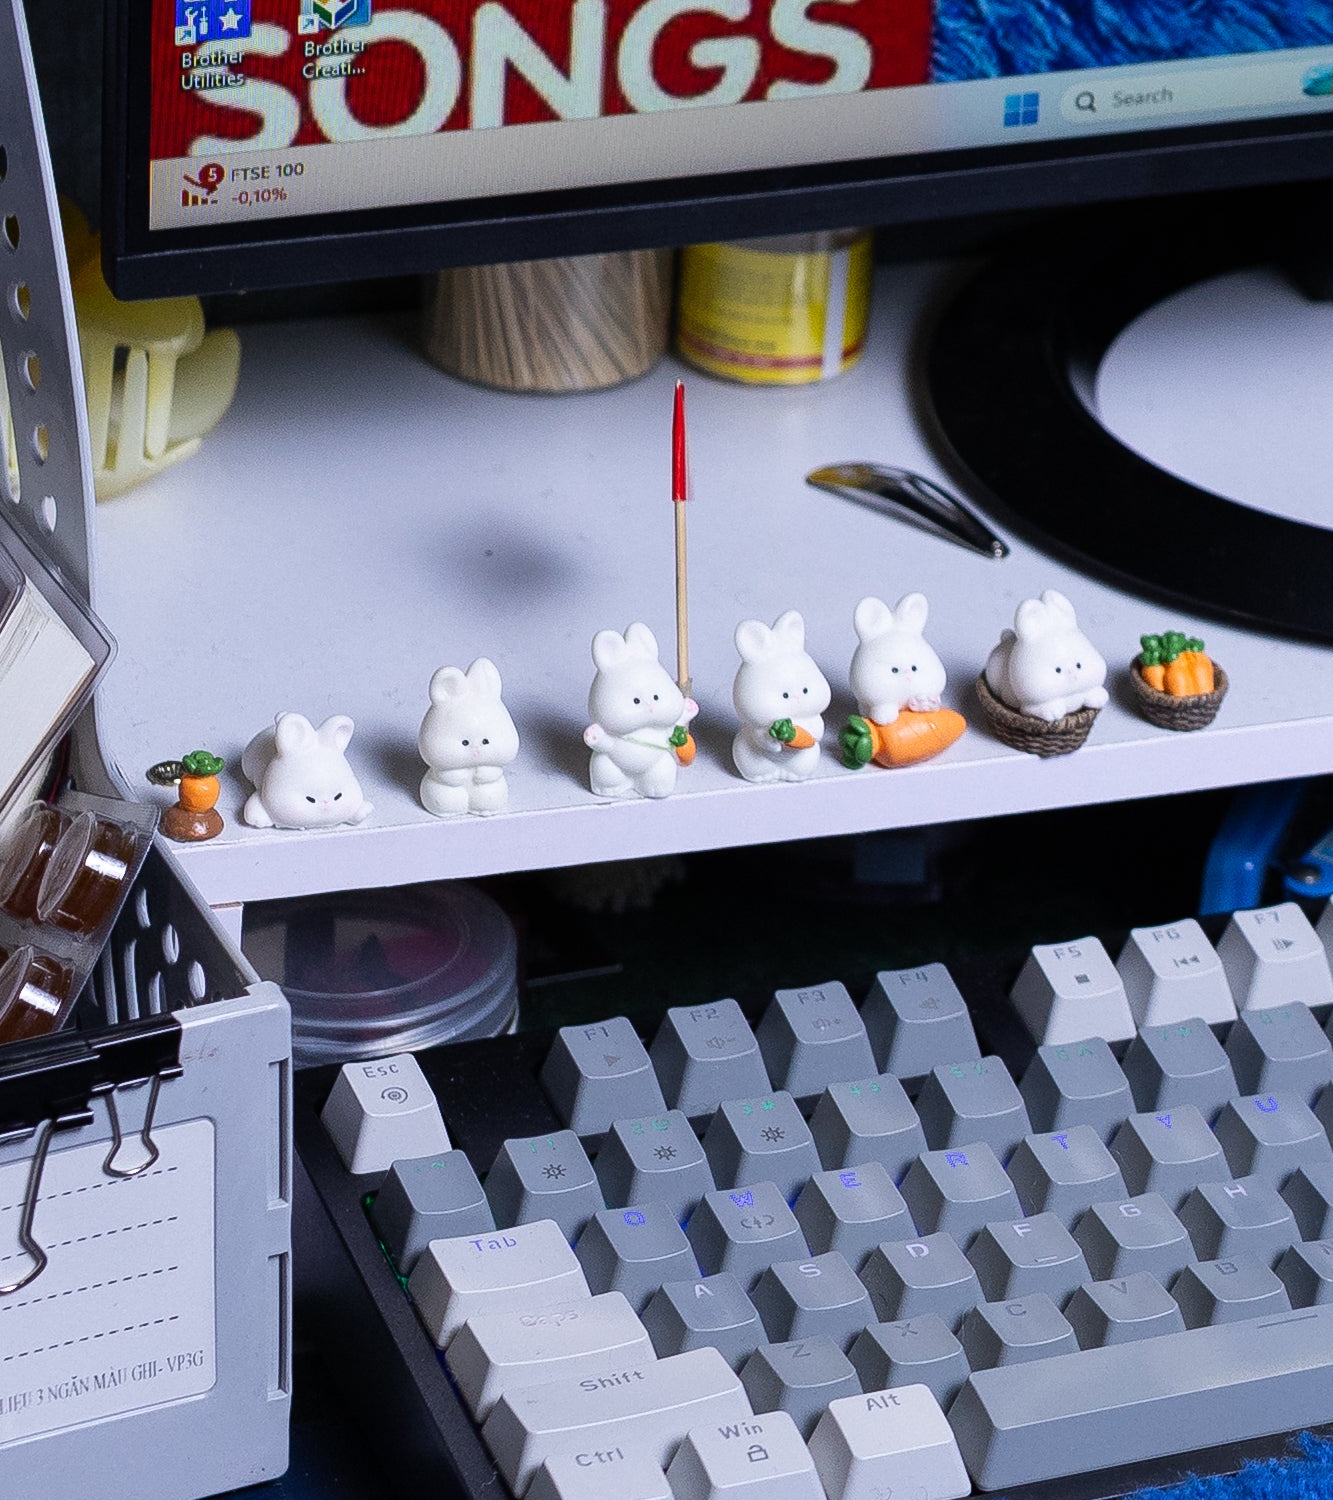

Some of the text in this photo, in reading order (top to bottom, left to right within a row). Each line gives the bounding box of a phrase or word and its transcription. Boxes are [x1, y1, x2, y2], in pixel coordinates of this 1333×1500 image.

[304, 39, 367, 57] Brother
[182, 49, 244, 68] Brother
[182, 72, 244, 90] Utilities
[1112, 87, 1173, 107] Search
[231, 162, 304, 182] FTSE 100
[363, 1063, 398, 1079] Esc
[839, 1172, 862, 1189] E
[1223, 1184, 1248, 1199] H
[1118, 1203, 1142, 1217] G
[1012, 1223, 1032, 1238] F
[469, 1236, 517, 1252] Tab
[905, 1243, 929, 1259] D
[798, 1263, 822, 1278] S
[694, 1283, 714, 1299] A
[1109, 1281, 1128, 1295] V
[1005, 1303, 1028, 1317] C
[894, 1322, 919, 1337] X
[786, 1344, 812, 1359] Z
[167, 1349, 204, 1373] VP3G
[578, 1367, 646, 1393] Shift
[866, 1393, 901, 1411] Alt
[718, 1421, 763, 1440] Win
[575, 1446, 624, 1469] Ctrl
